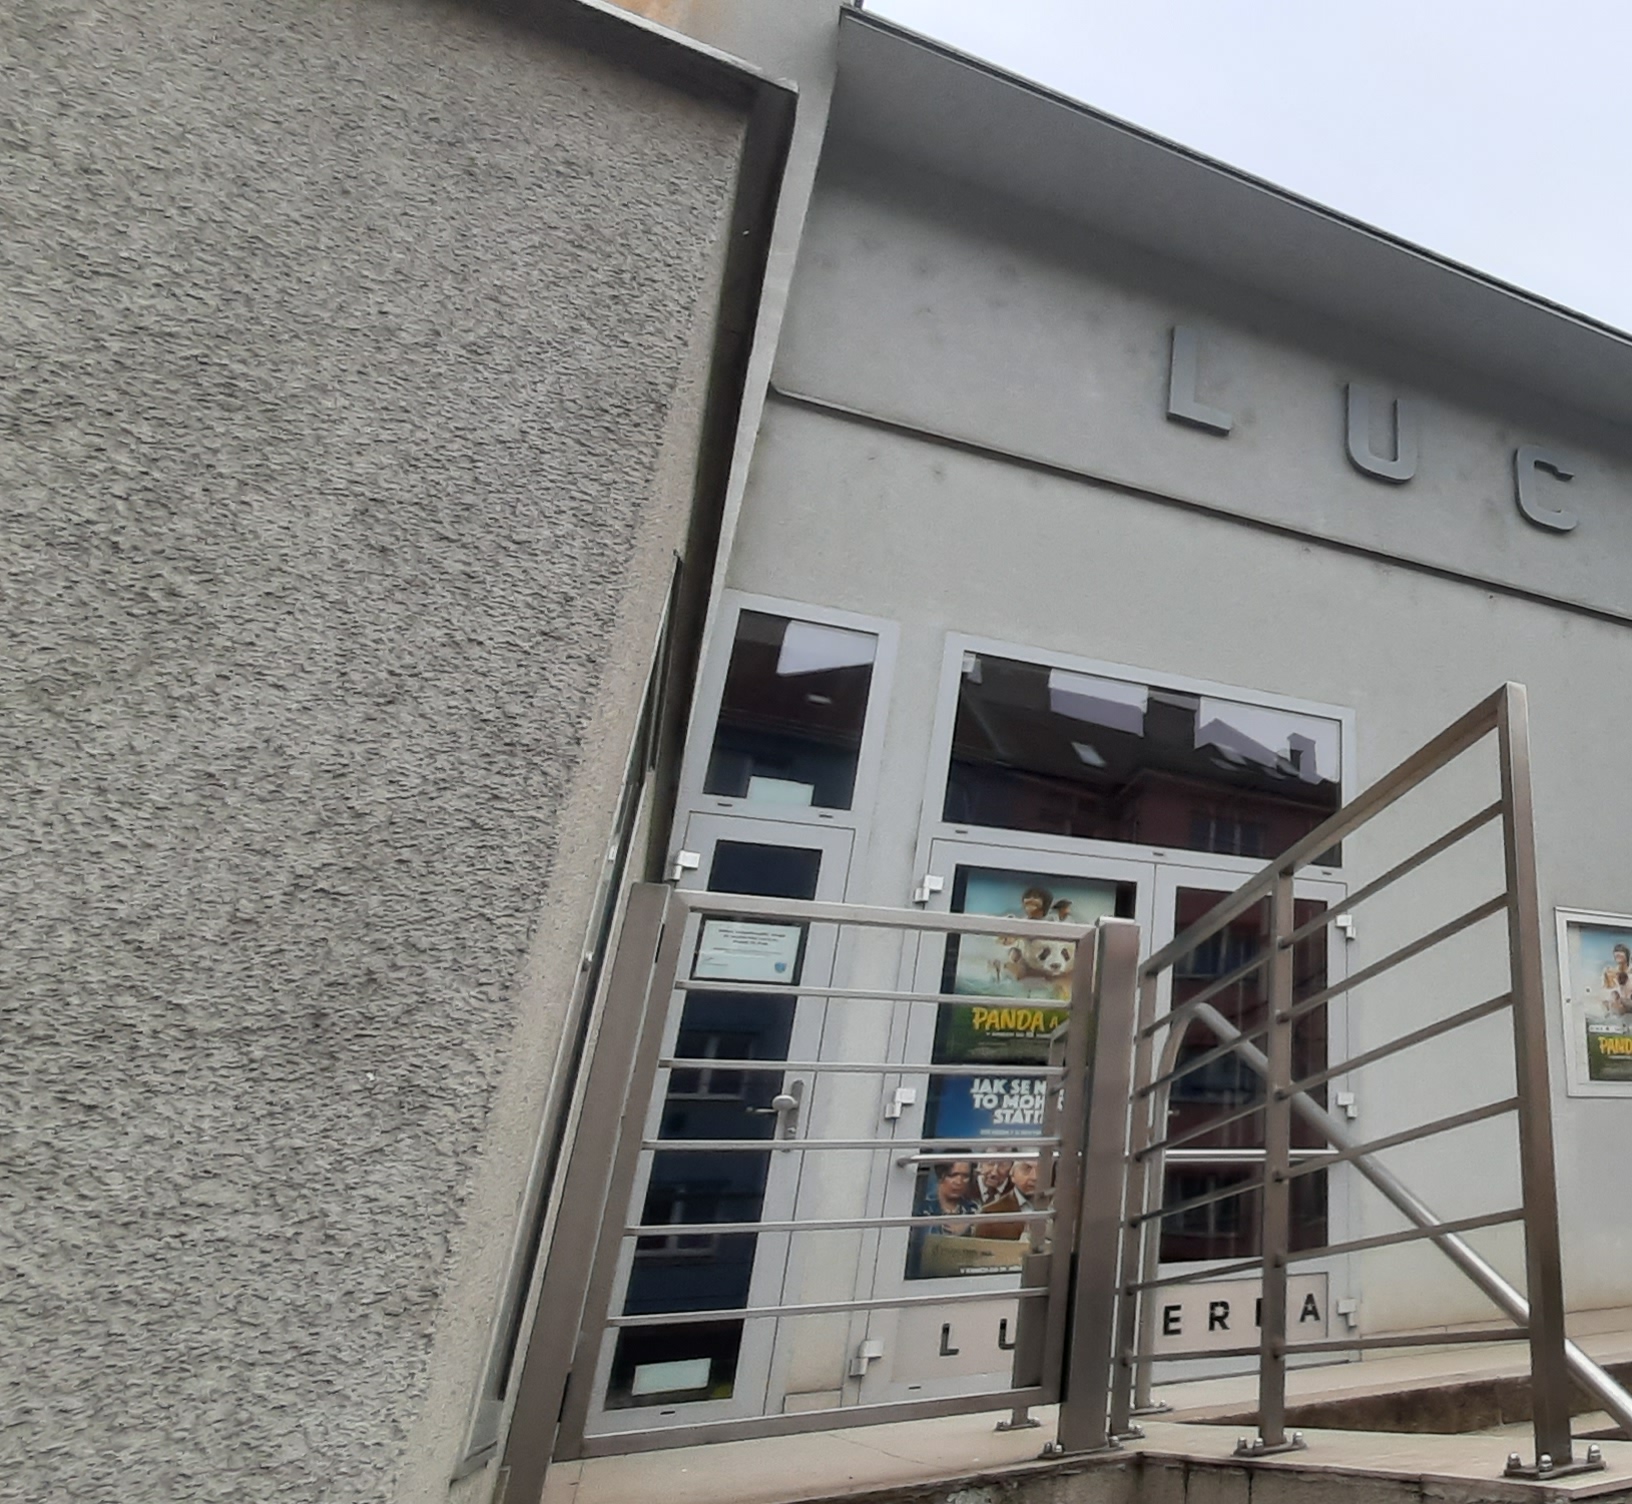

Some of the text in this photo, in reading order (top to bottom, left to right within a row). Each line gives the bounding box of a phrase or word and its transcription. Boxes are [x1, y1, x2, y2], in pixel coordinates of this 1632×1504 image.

[972, 1006, 1044, 1032] PANDA
[970, 1078, 1007, 1094] JAK
[1010, 1080, 1031, 1095] SE
[972, 1094, 1062, 1110] TO MOH
[939, 1293, 1321, 1357] LUERA
